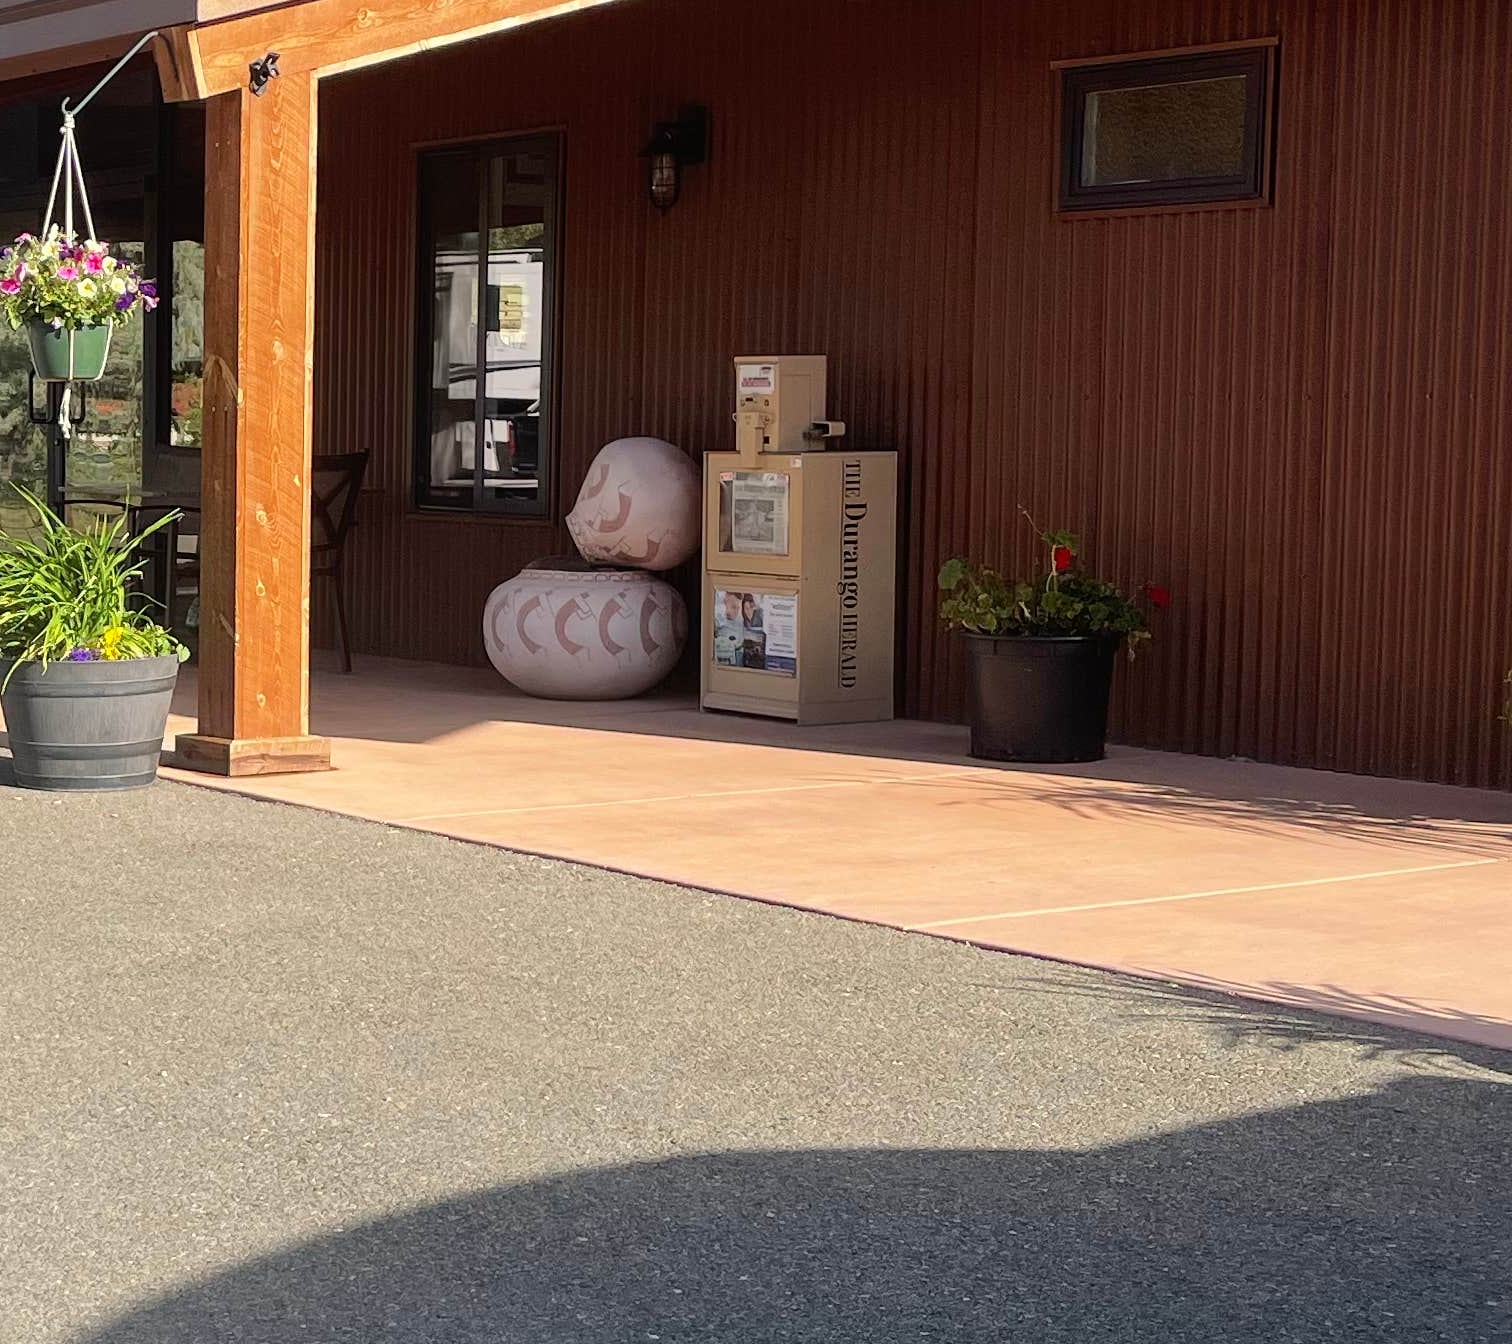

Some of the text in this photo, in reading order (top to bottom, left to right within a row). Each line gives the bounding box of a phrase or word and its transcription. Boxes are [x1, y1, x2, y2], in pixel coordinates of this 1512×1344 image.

[837, 459, 867, 688] THE Durango HERALD
